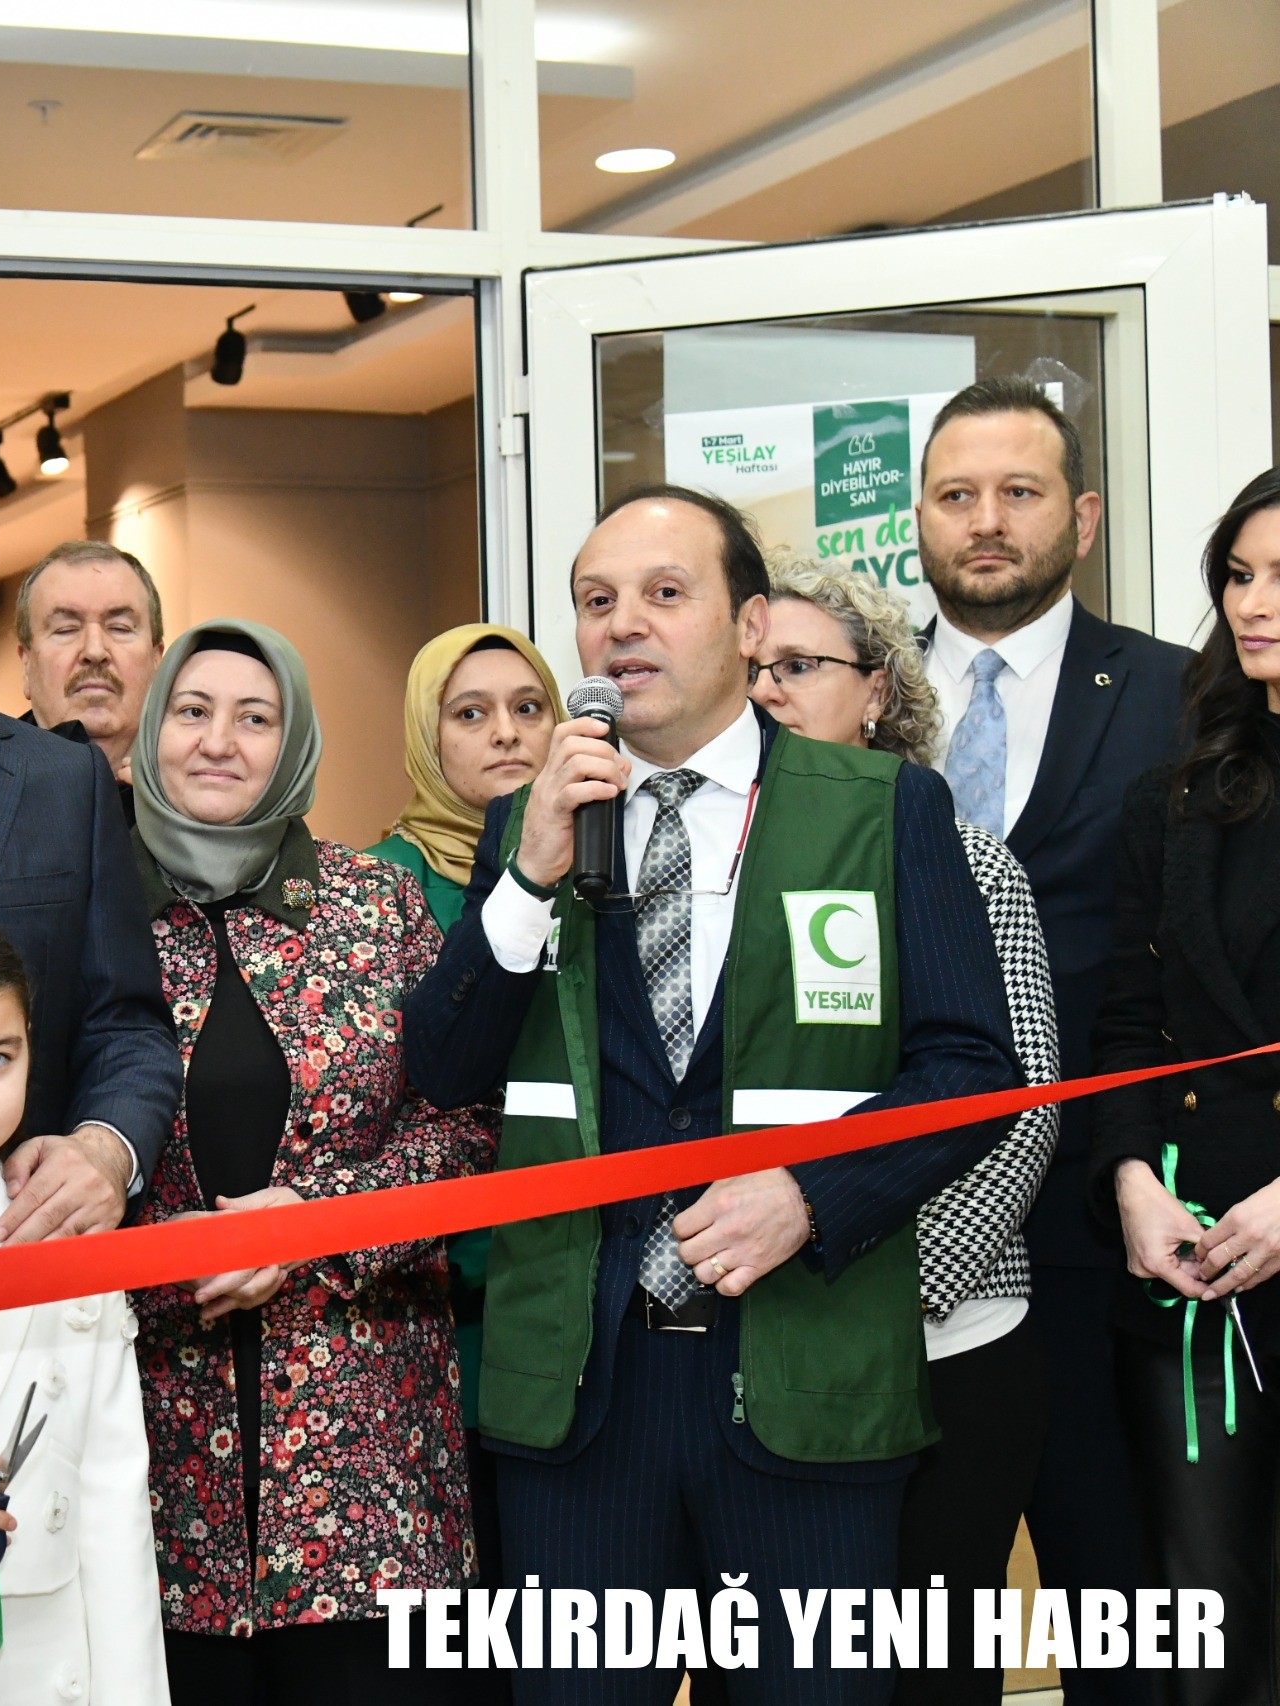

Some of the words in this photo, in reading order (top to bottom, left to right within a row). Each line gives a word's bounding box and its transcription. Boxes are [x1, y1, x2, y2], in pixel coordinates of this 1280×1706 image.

[718, 435, 741, 445] Mart
[843, 457, 881, 477] HAYIR
[850, 490, 876, 507] SAN
[816, 527, 865, 559] sen
[875, 502, 913, 548] de
